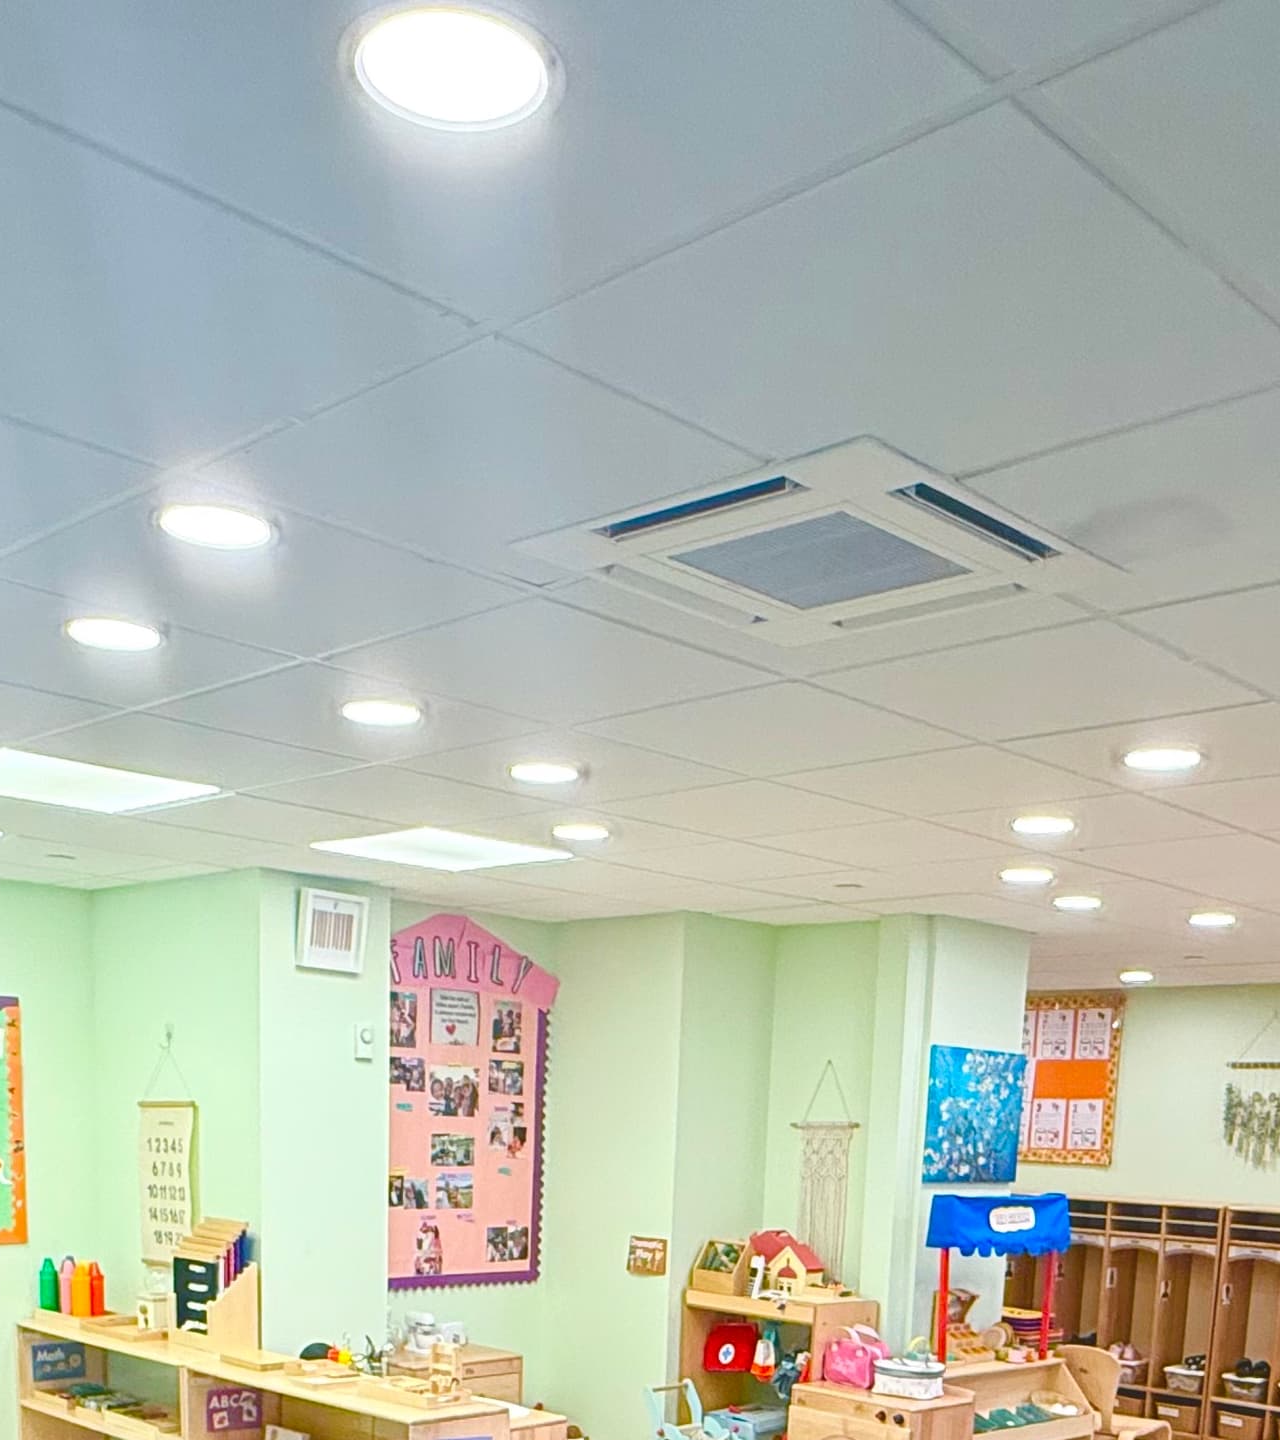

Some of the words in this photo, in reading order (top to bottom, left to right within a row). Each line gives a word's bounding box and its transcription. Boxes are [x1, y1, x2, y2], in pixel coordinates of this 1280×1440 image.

[154, 1137, 161, 1153] 2
[163, 1137, 169, 1153] 3
[170, 1138, 176, 1153] 4
[152, 1161, 158, 1177] 6
[36, 1347, 65, 1362] Math
[209, 1393, 240, 1409] ABC
